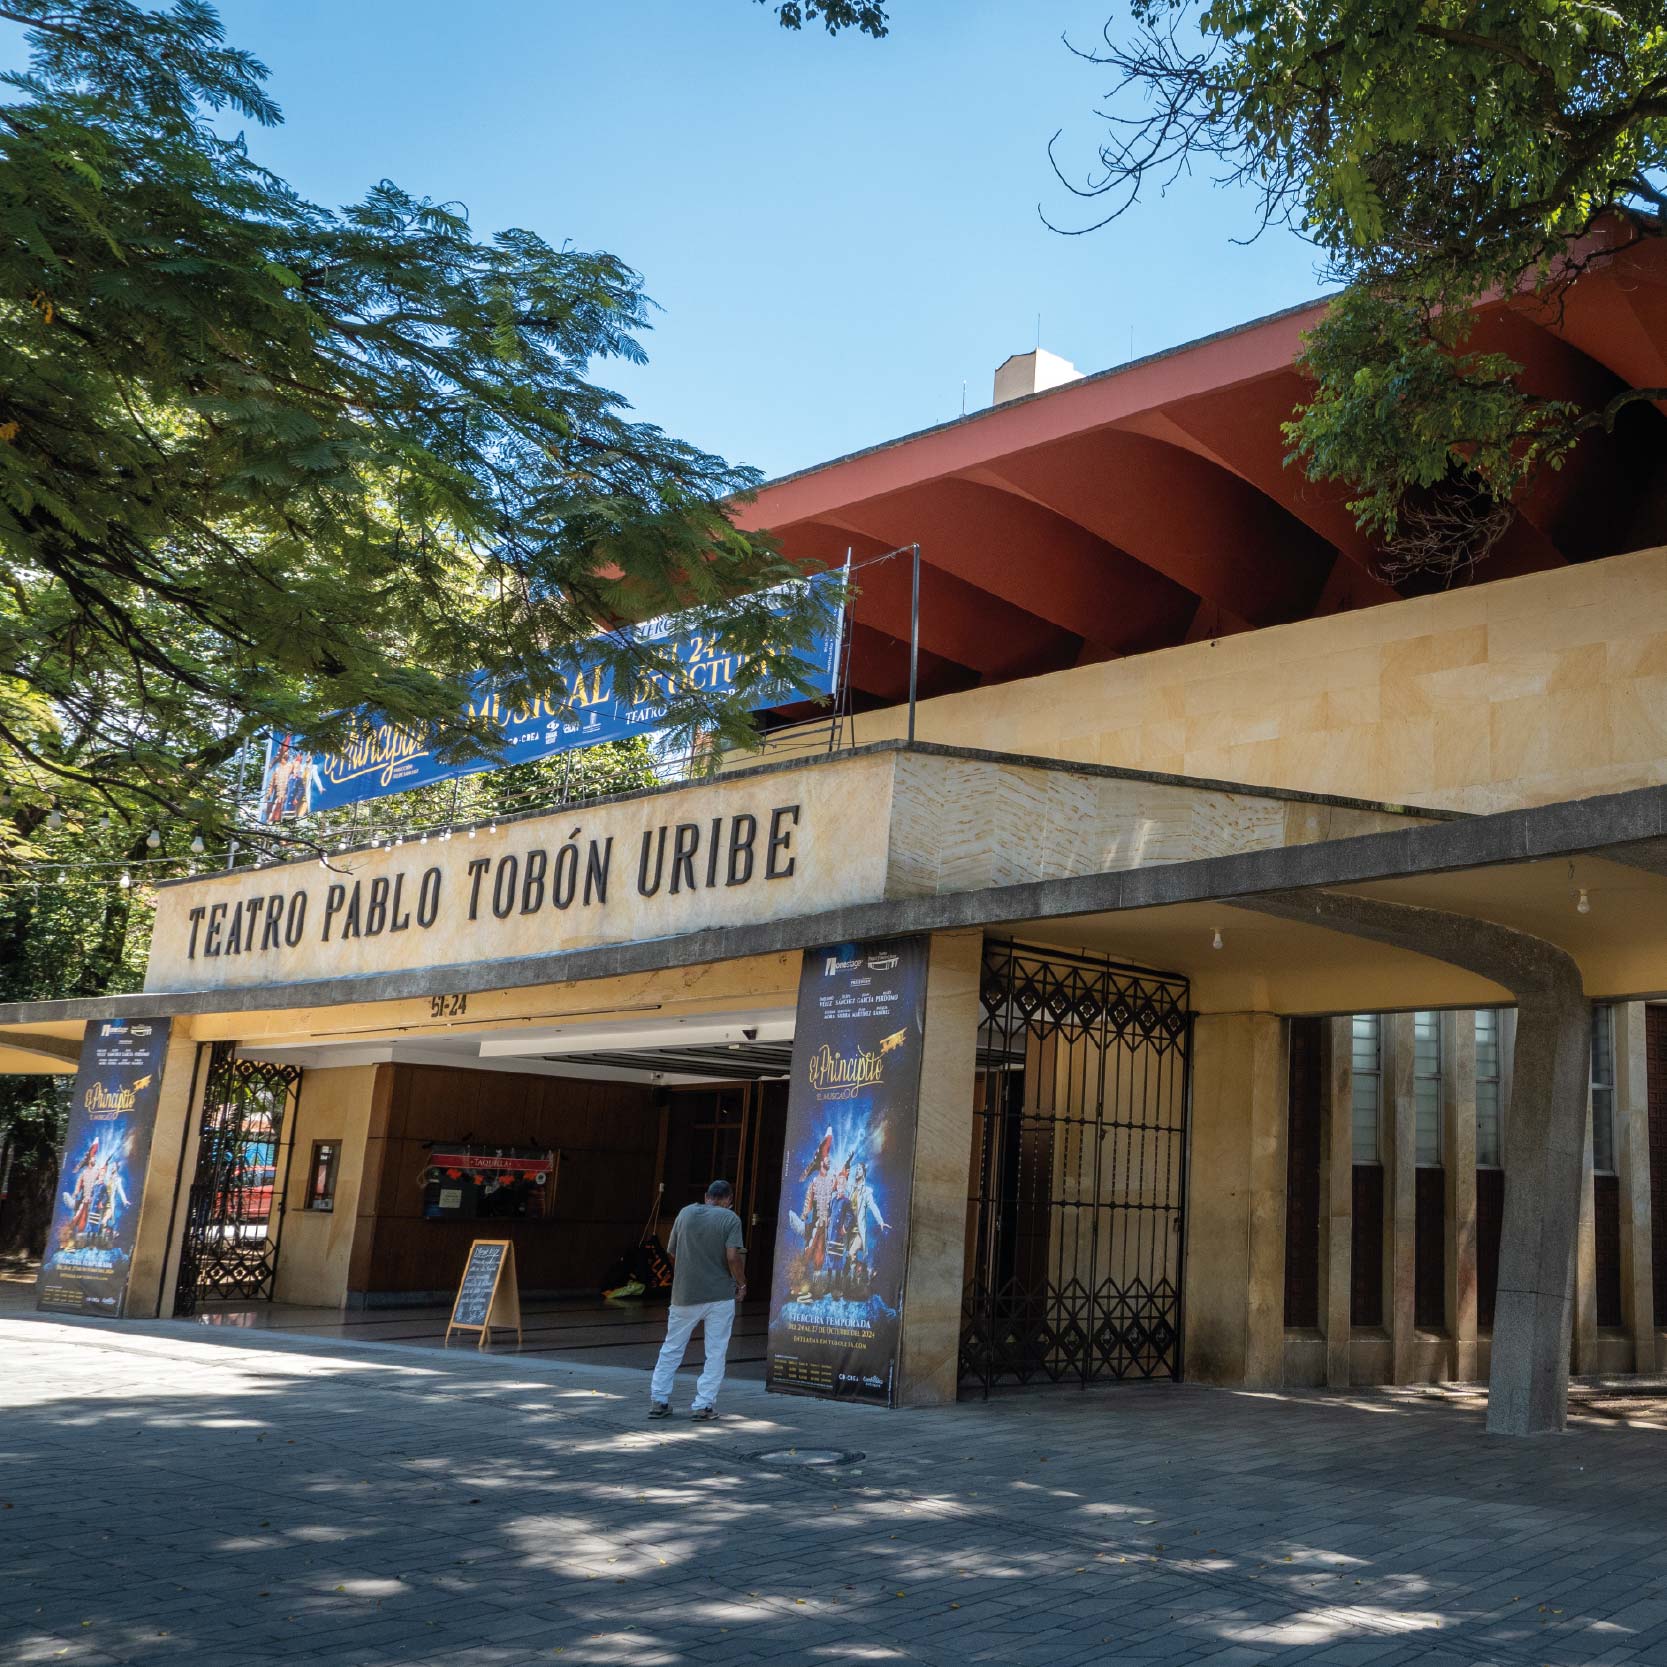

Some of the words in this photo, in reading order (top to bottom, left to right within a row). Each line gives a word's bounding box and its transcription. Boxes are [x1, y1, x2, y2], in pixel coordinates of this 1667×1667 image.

[186, 889, 308, 960] TEATRO
[320, 865, 443, 942] PABLO
[467, 826, 614, 921] TOBÓN
[637, 804, 801, 898] URIBE
[431, 994, 467, 1017] 51-24
[809, 1055, 819, 1084] El
[819, 1044, 884, 1096] Principito
[826, 1317, 871, 1329] TEMPORADA
